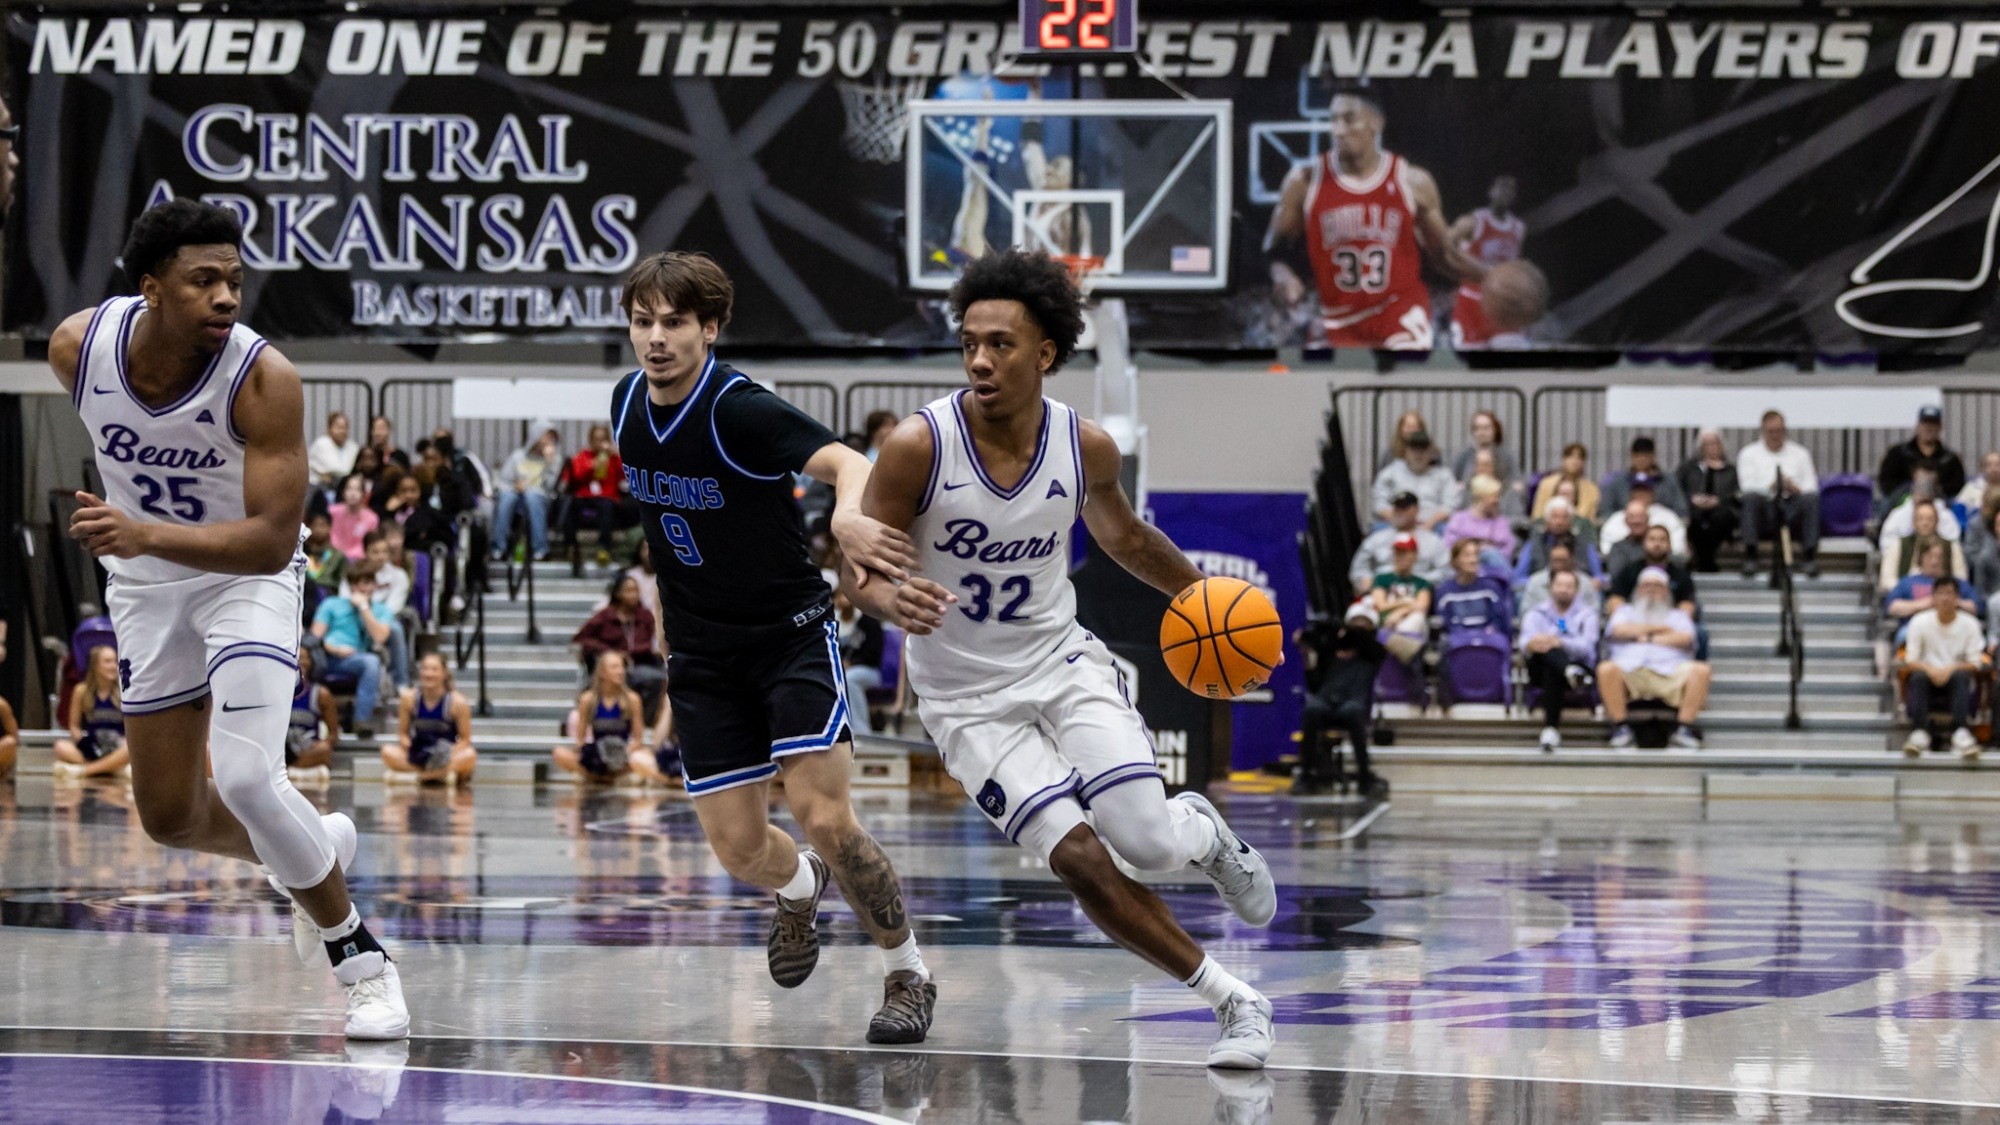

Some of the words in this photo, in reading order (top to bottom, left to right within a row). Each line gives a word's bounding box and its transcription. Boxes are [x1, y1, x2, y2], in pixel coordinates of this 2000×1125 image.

[28, 19, 305, 75] NAMED
[327, 19, 487, 76] ONE
[505, 20, 610, 76] OF
[635, 20, 780, 76] THE
[797, 20, 877, 77] 50
[886, 20, 1291, 78] GREST
[1308, 21, 1479, 79] NBA
[1504, 21, 1872, 79] PLAYERS
[1894, 20, 2000, 79] OF
[1038, 0, 1116, 49] 22
[183, 102, 589, 183] CENTRAL
[141, 178, 639, 273] RKANSAS
[1331, 243, 1392, 294] 33
[98, 423, 227, 470] Bears
[131, 473, 207, 523] 25
[660, 512, 704, 567] 9
[933, 518, 1061, 565] Bears
[958, 571, 1032, 624] 32
